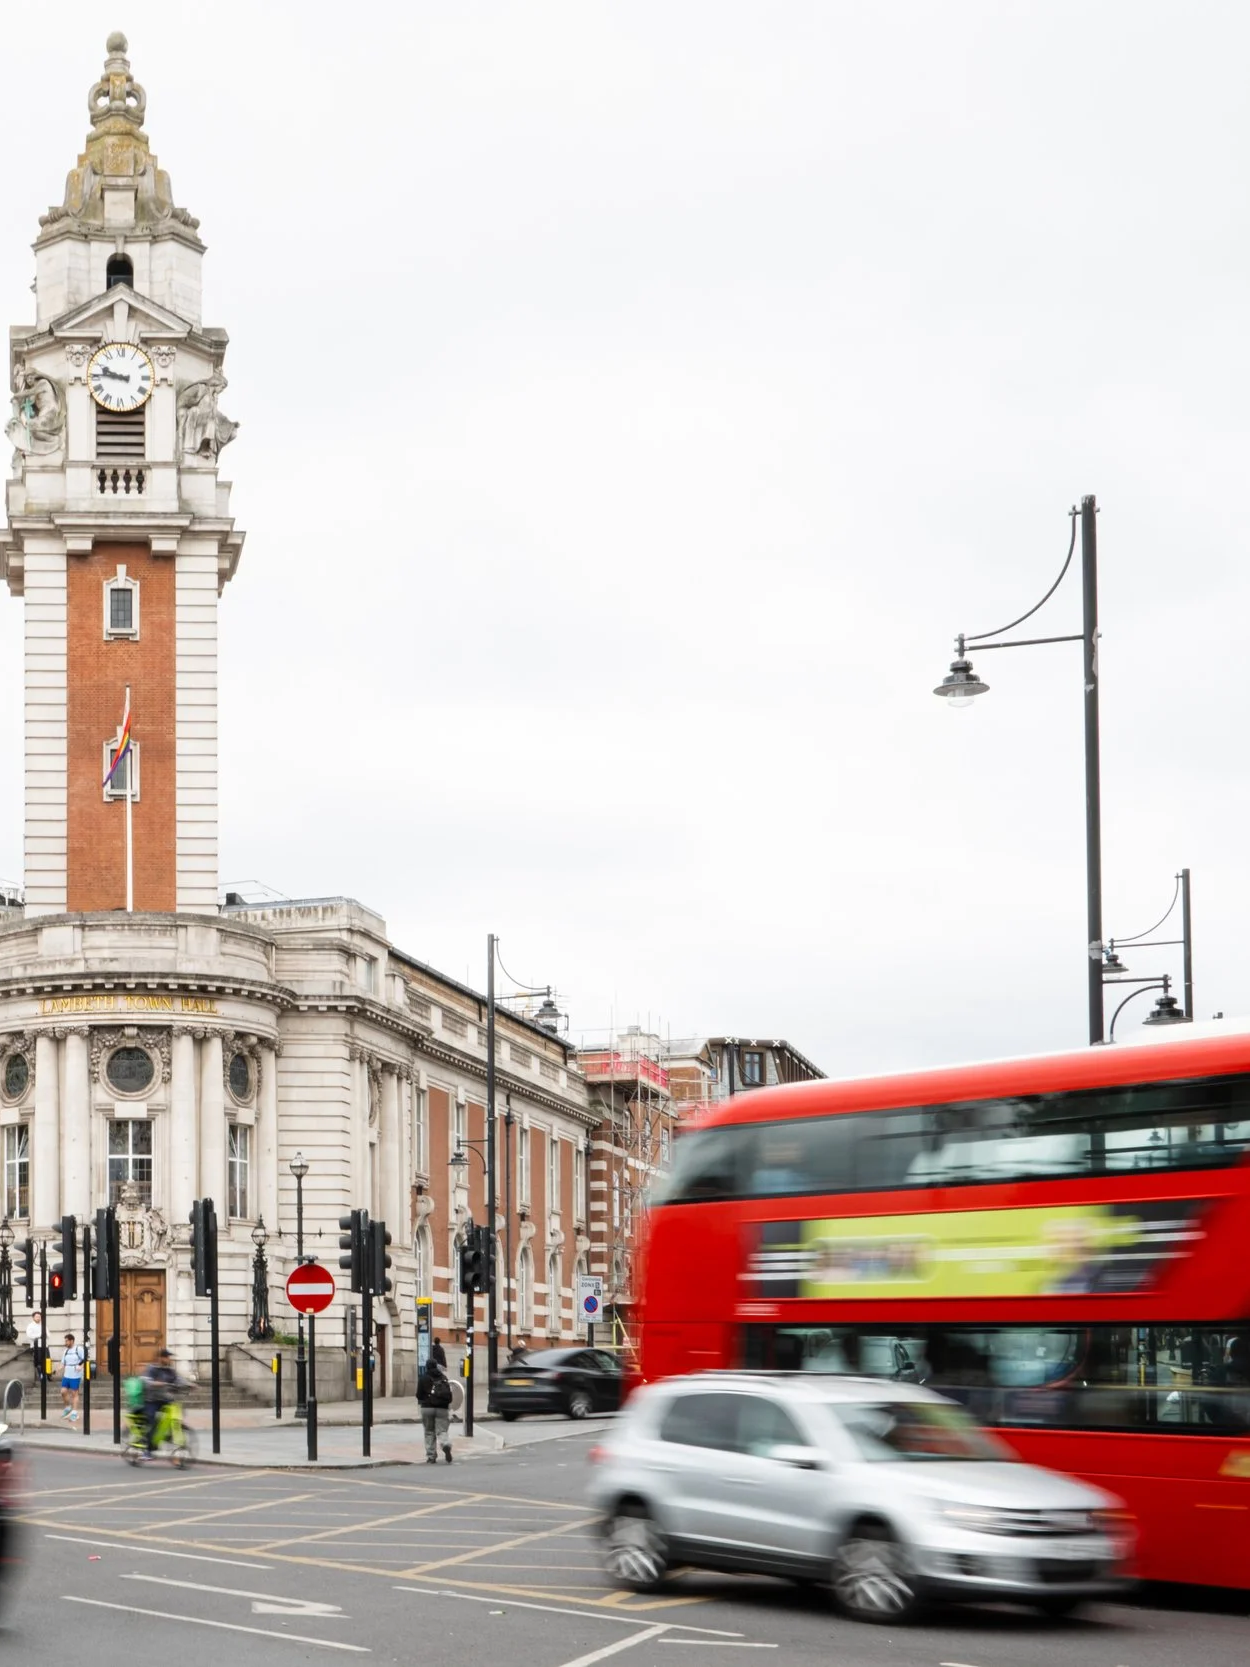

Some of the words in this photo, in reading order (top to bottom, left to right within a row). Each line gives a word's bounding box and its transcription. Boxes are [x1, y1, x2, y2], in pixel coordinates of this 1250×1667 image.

[40, 996, 114, 1014] LAMBETH
[124, 995, 174, 1011] TOWN
[181, 997, 218, 1014] HALL
